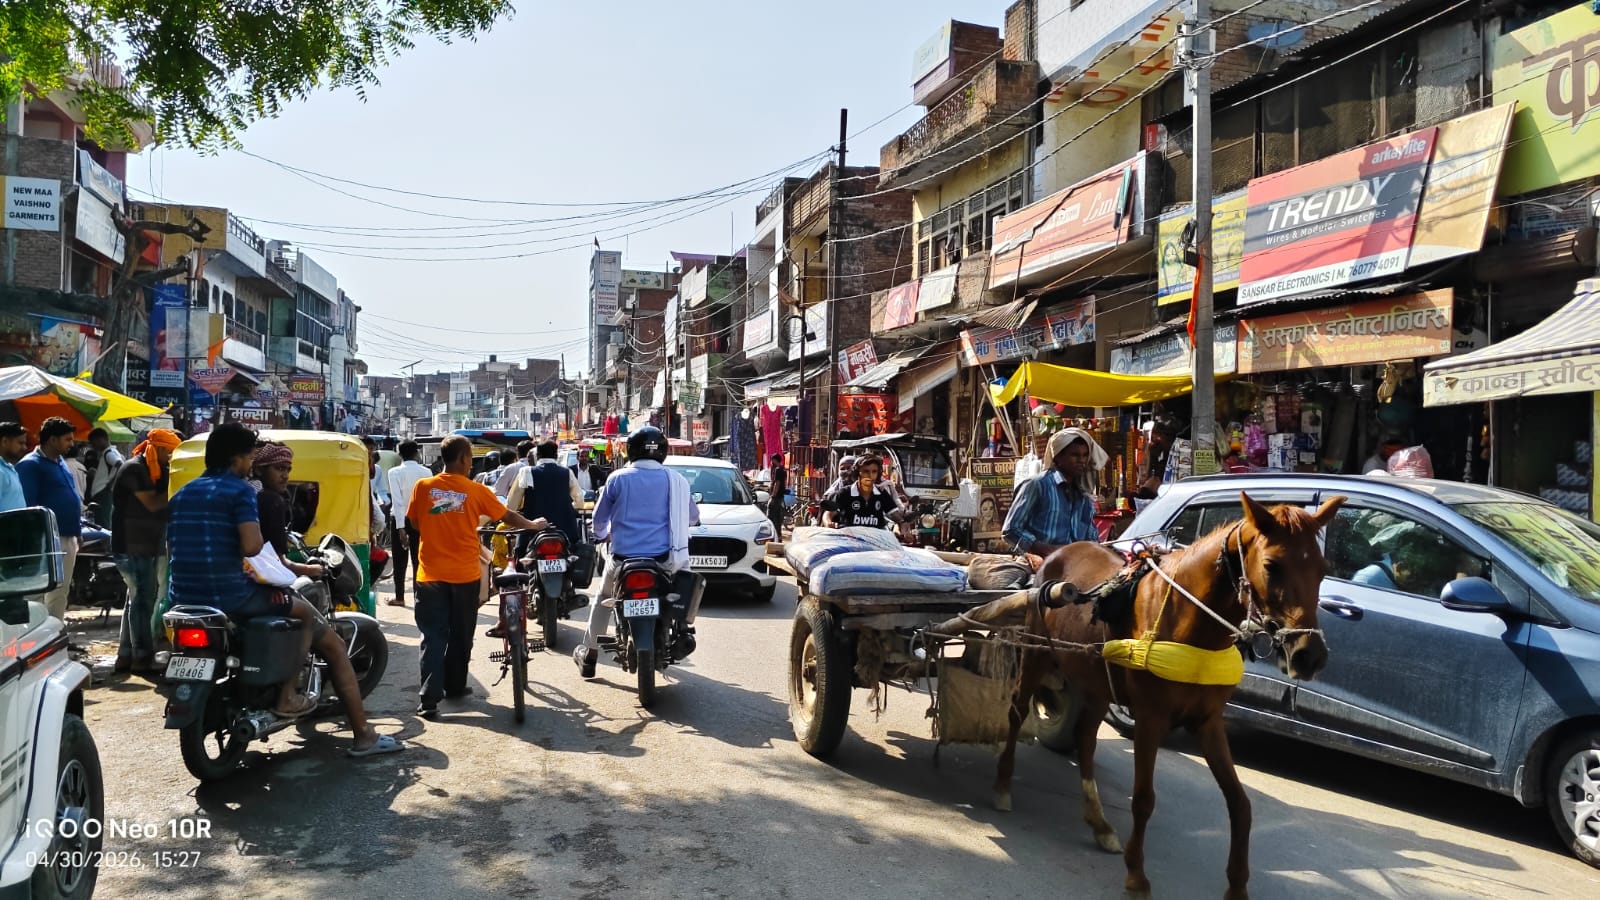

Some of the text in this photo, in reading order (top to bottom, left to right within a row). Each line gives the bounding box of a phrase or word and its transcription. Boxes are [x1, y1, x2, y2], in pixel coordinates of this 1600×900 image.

[1372, 138, 1426, 165] arkaylite
[13, 186, 53, 196] NEW MAA
[13, 199, 51, 209] VAISHNO
[1266, 172, 1397, 232] TRENDY
[8, 211, 55, 222] GARMENTS
[1265, 209, 1387, 246] Wires & Modular Switches
[1241, 280, 1276, 299] SANSKAR
[1276, 270, 1331, 293] ELECTRONICS
[1336, 267, 1346, 280] M.
[1348, 255, 1400, 277] 7607794091
[1262, 323, 1322, 348] संस्कार
[1459, 370, 1534, 395] कान्हा
[853, 514, 878, 526] bwin
[629, 599, 655, 608] UP73A
[177, 658, 207, 669] UP 73
